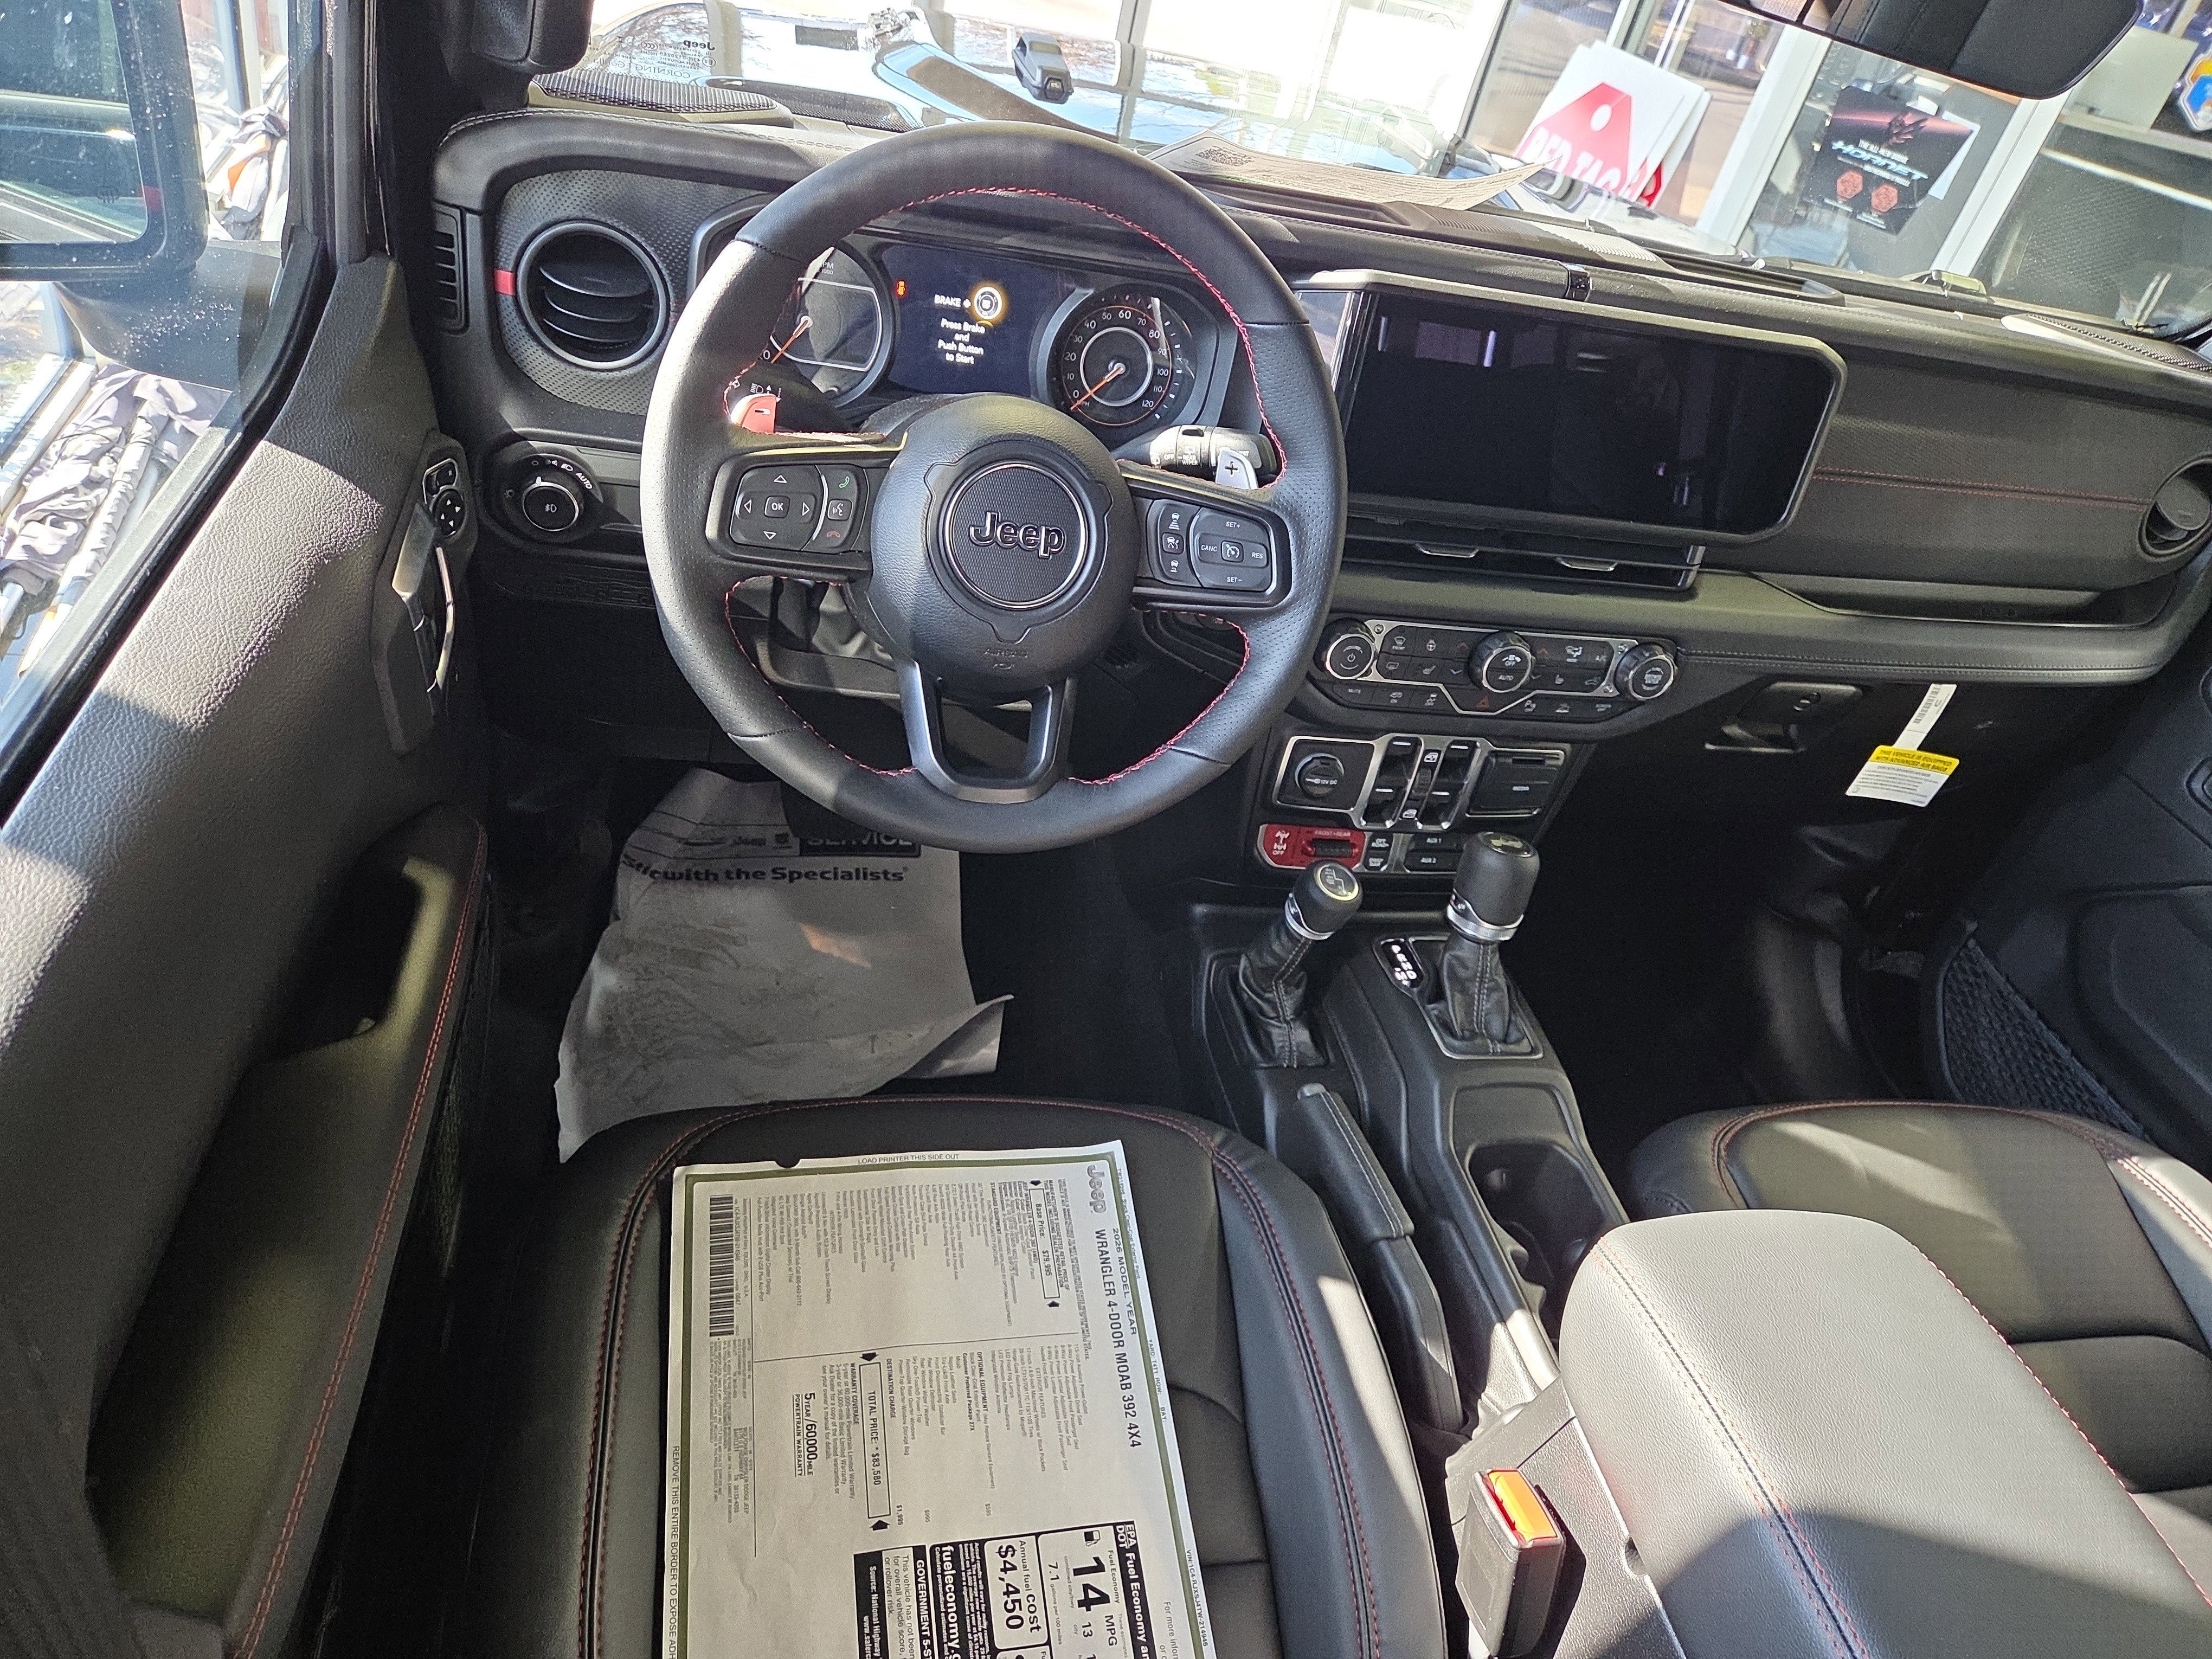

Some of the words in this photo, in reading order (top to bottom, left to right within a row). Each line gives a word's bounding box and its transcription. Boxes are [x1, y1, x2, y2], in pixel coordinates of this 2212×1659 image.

[1831, 140, 1928, 180] HORNET
[934, 294, 962, 307] BRAKE
[941, 318, 962, 330] Press
[963, 321, 986, 334] Brake
[1084, 320, 1096, 329] 40
[1102, 312, 1112, 320] 50
[1118, 310, 1131, 319] 60
[1138, 318, 1147, 326] 70
[954, 332, 970, 342] and
[1148, 329, 1160, 339] 80
[763, 350, 770, 359] 0
[937, 339, 957, 351] Push
[958, 342, 984, 355] Button
[946, 352, 954, 361] to
[956, 353, 974, 364] Start
[1064, 352, 1077, 361] 20
[1072, 390, 1079, 398] 0
[575, 470, 593, 489] AUTO
[771, 501, 783, 511] OK
[969, 512, 1064, 560] Jeep
[1201, 544, 1218, 552] CANC
[663, 867, 719, 881] with
[724, 867, 766, 880] the
[771, 866, 904, 883] Specialists
[1391, 944, 1401, 954] P
[1396, 953, 1407, 962] R
[1395, 971, 1407, 981] M
[1401, 962, 1413, 970] N
[1406, 970, 1417, 979] D
[1086, 1165, 1106, 1213] Jeep
[1054, 1222, 1063, 1250] SUGGESTED
[1113, 1227, 1122, 1252] 2026
[1041, 1250, 1052, 1276] $79,995
[1054, 1254, 1064, 1287] PREPARATION
[1095, 1229, 1116, 1296] WRANGLER
[1117, 1256, 1129, 1298] MODEL
[1107, 1301, 1124, 1348] 4-DOOR
[1126, 1301, 1136, 1335] YEAR
[1115, 1352, 1131, 1390] MOAB
[868, 1390, 876, 1415] TOTAL
[980, 1379, 988, 1411] EQUIPMENT
[1122, 1394, 1136, 1418] 392
[869, 1417, 878, 1443] PRICE:
[1127, 1423, 1141, 1447] 4X4
[871, 1452, 881, 1485] $83,580
[1116, 1525, 1127, 1548] DOT
[1126, 1524, 1136, 1547] EPA
[884, 1557, 890, 1565] or
[1019, 1540, 1029, 1571] Annual
[1126, 1552, 1139, 1578] Fuel
[1048, 1561, 1059, 1580] 7.1
[1064, 1555, 1072, 1583] combined
[670, 1583, 677, 1596] TO
[894, 1568, 902, 1595] overall
[903, 1573, 911, 1602] vehicle
[995, 1545, 1024, 1629] $4,450
[1023, 1574, 1032, 1591] fuel
[1110, 1568, 1120, 1603] Economy
[871, 1593, 879, 1624] National
[916, 1560, 930, 1636] GOVERNMENT
[1072, 1557, 1110, 1611] 14
[1104, 1615, 1117, 1645] MPG
[896, 1597, 904, 1627] vehicle
[1026, 1593, 1041, 1632] cost
[1130, 1582, 1146, 1642] Economy
[1082, 1622, 1092, 1637] 13
[1166, 1616, 1174, 1636] more
[872, 1625, 880, 1656] Highway
[1159, 1645, 1166, 1653] or
